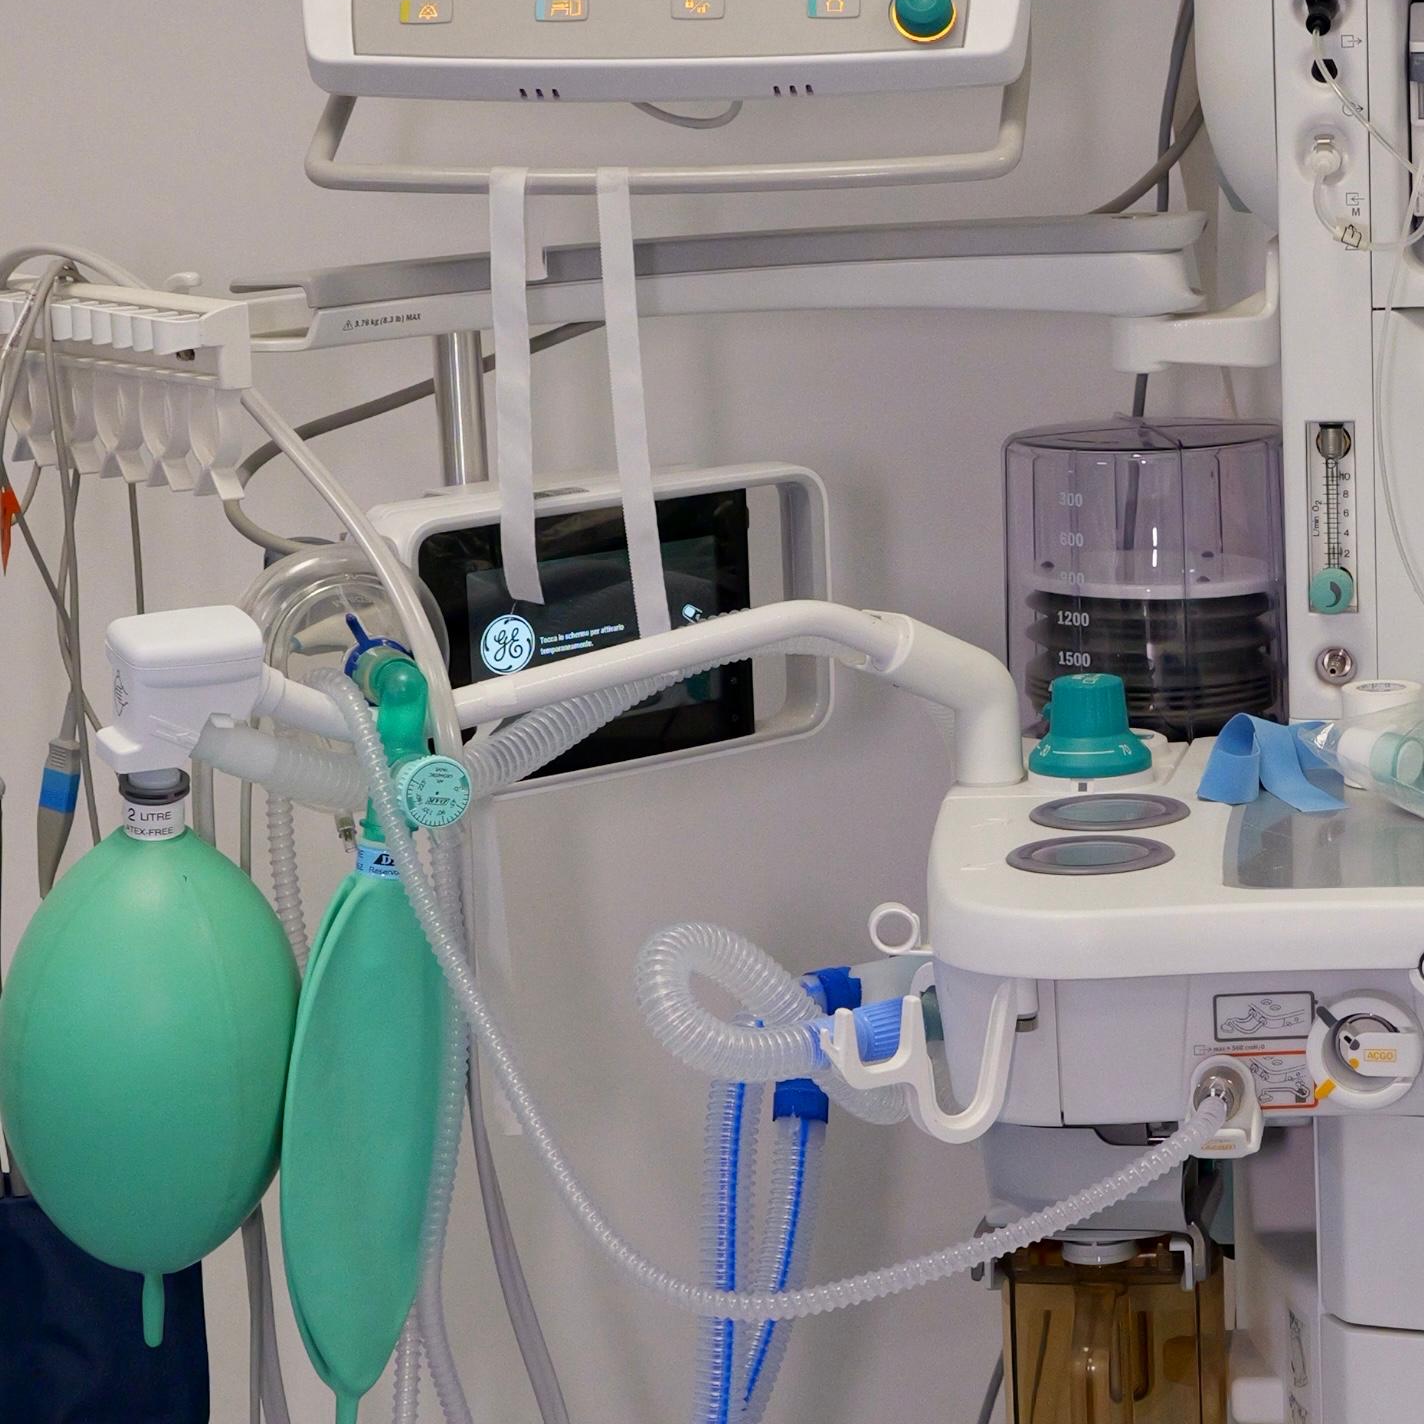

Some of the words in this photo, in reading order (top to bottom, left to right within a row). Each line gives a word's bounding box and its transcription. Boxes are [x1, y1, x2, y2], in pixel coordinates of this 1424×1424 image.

[1058, 492, 1084, 507] 300
[1342, 489, 1349, 498] 8
[1059, 532, 1084, 547] 600
[1343, 529, 1350, 537] 4
[1057, 610, 1090, 627] 1200
[540, 634, 558, 644] Tocca
[564, 629, 590, 640] schermo
[589, 628, 601, 638] per
[1058, 651, 1091, 667] 1500
[127, 807, 136, 822] 2
[140, 811, 172, 822] LITRE
[1366, 1050, 1395, 1061] ACGO
